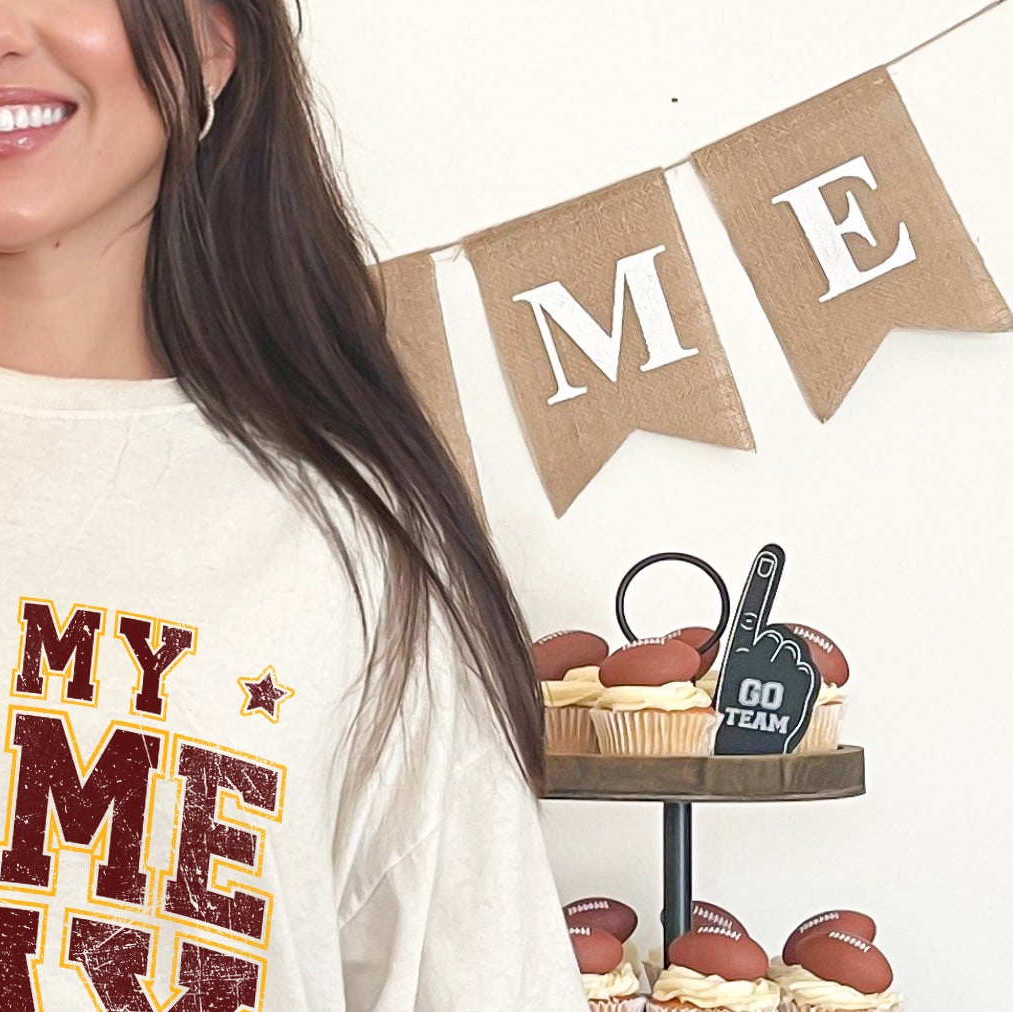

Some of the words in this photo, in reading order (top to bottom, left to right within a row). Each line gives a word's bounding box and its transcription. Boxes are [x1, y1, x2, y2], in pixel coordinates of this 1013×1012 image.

[11, 597, 198, 720] MY
[738, 678, 785, 711] GO
[725, 707, 790, 734] TEAM
